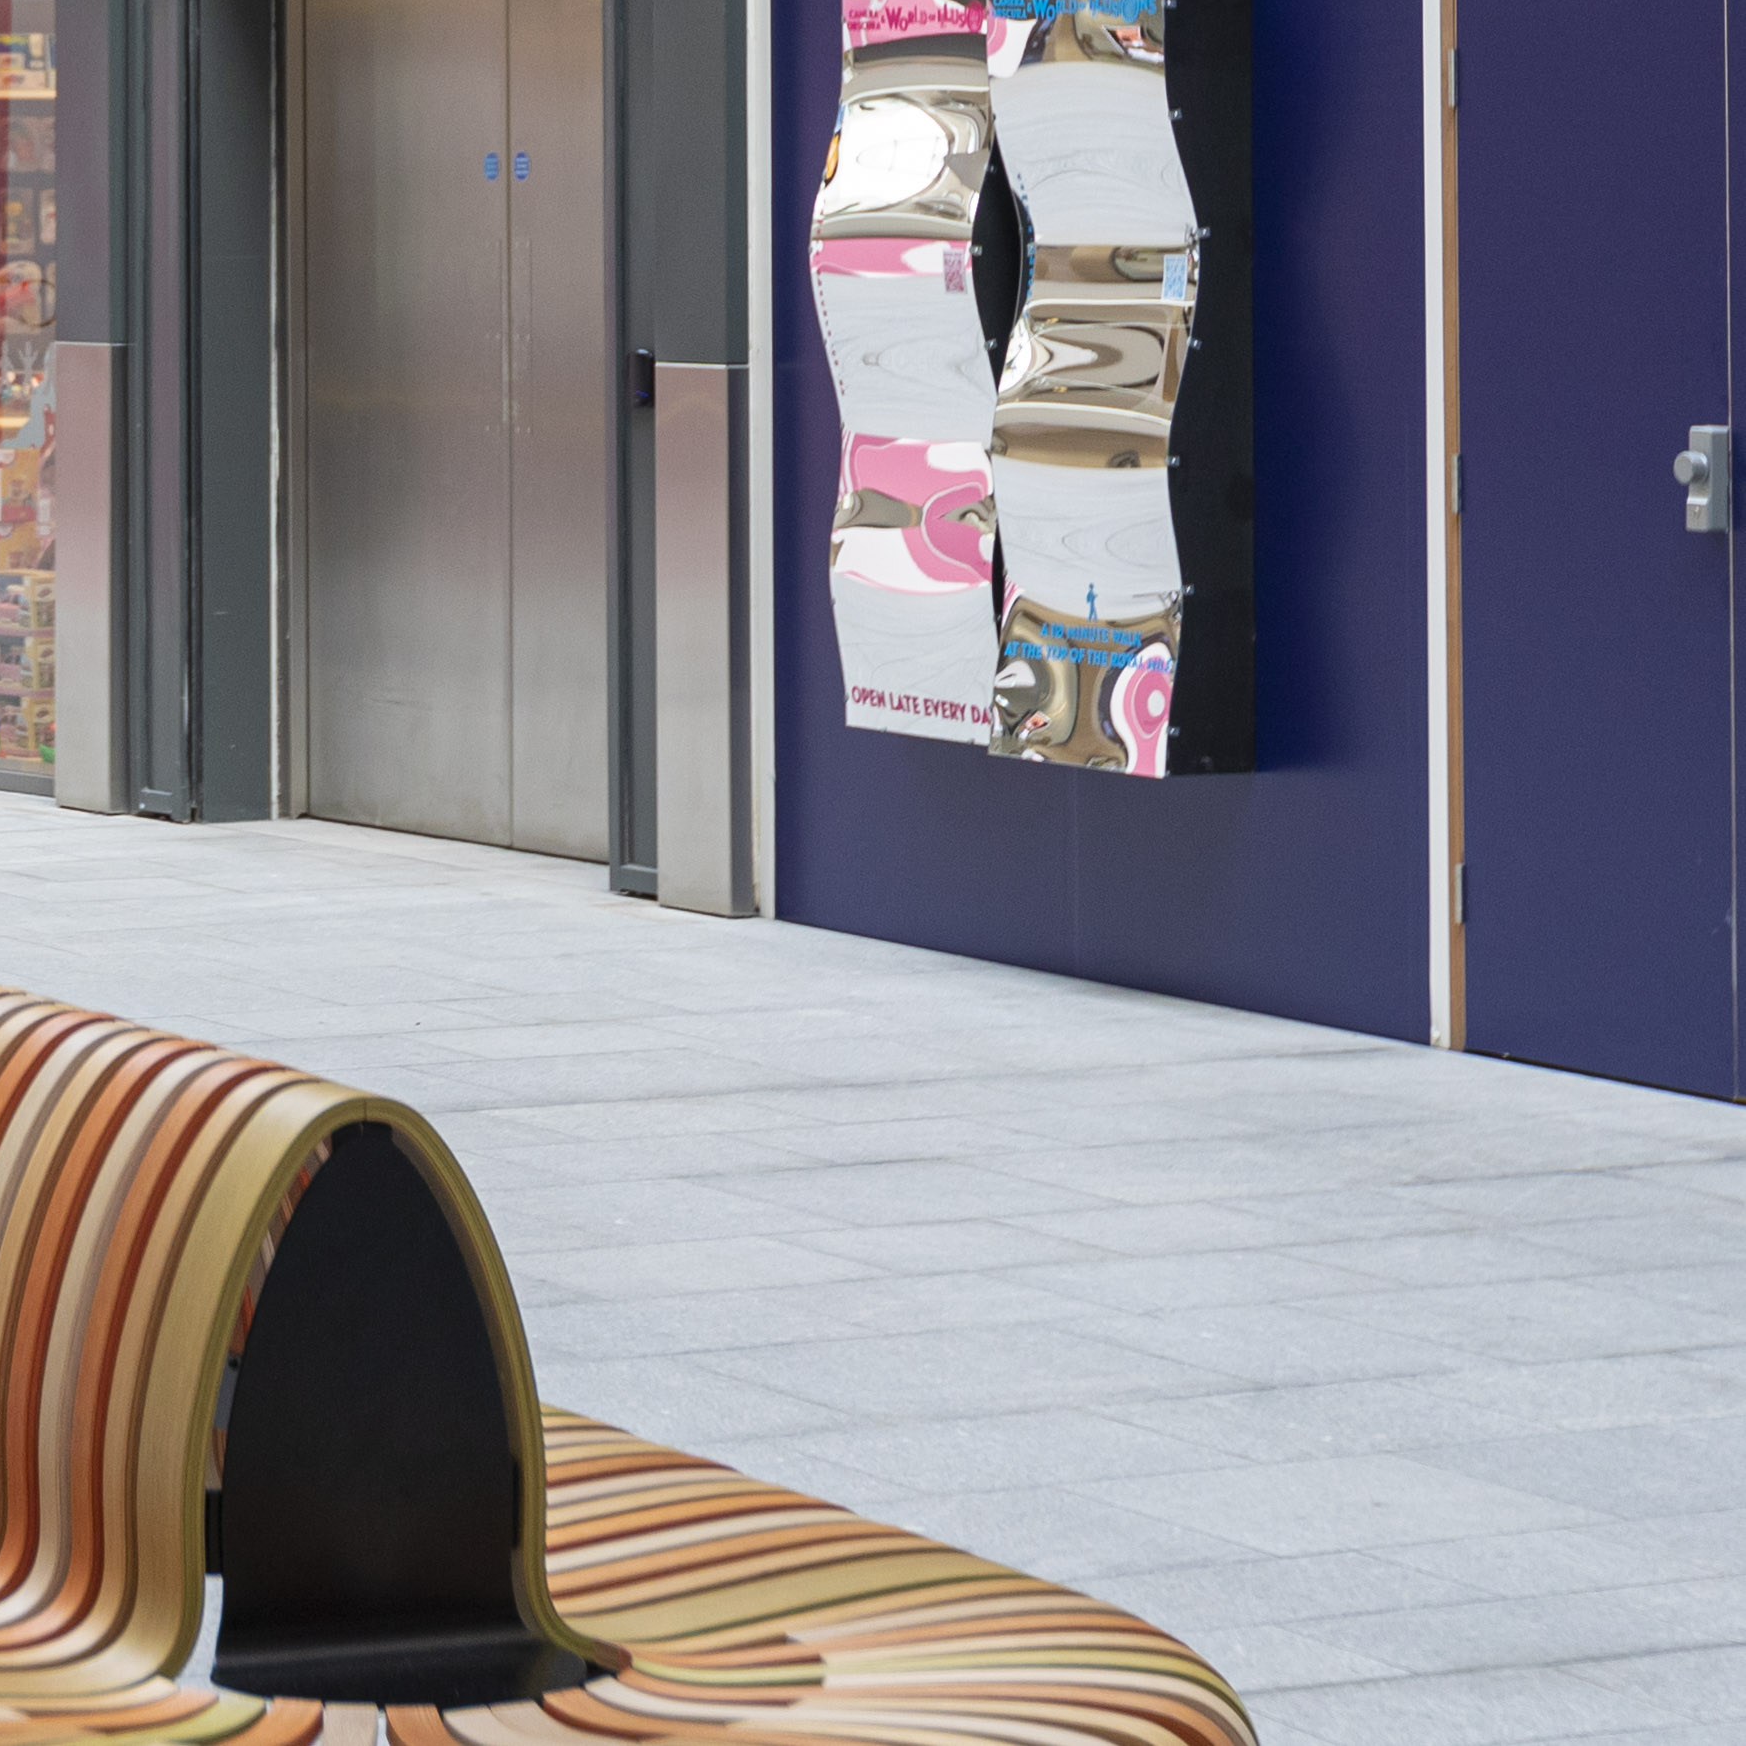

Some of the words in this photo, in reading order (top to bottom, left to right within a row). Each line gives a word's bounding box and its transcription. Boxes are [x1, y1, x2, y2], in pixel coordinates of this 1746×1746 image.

[1040, 623, 1049, 638] A
[1066, 626, 1108, 644] MINUTE
[1111, 628, 1142, 648] WALK
[1004, 641, 1018, 657] AT
[1021, 642, 1042, 660] THE
[1045, 644, 1068, 662] TOP
[1069, 647, 1085, 664] OF
[1087, 649, 1108, 666] THE
[1110, 651, 1143, 669] ROYAL
[851, 685, 886, 708] OPEN
[889, 691, 921, 715] LATE
[923, 697, 966, 723] EVERY
